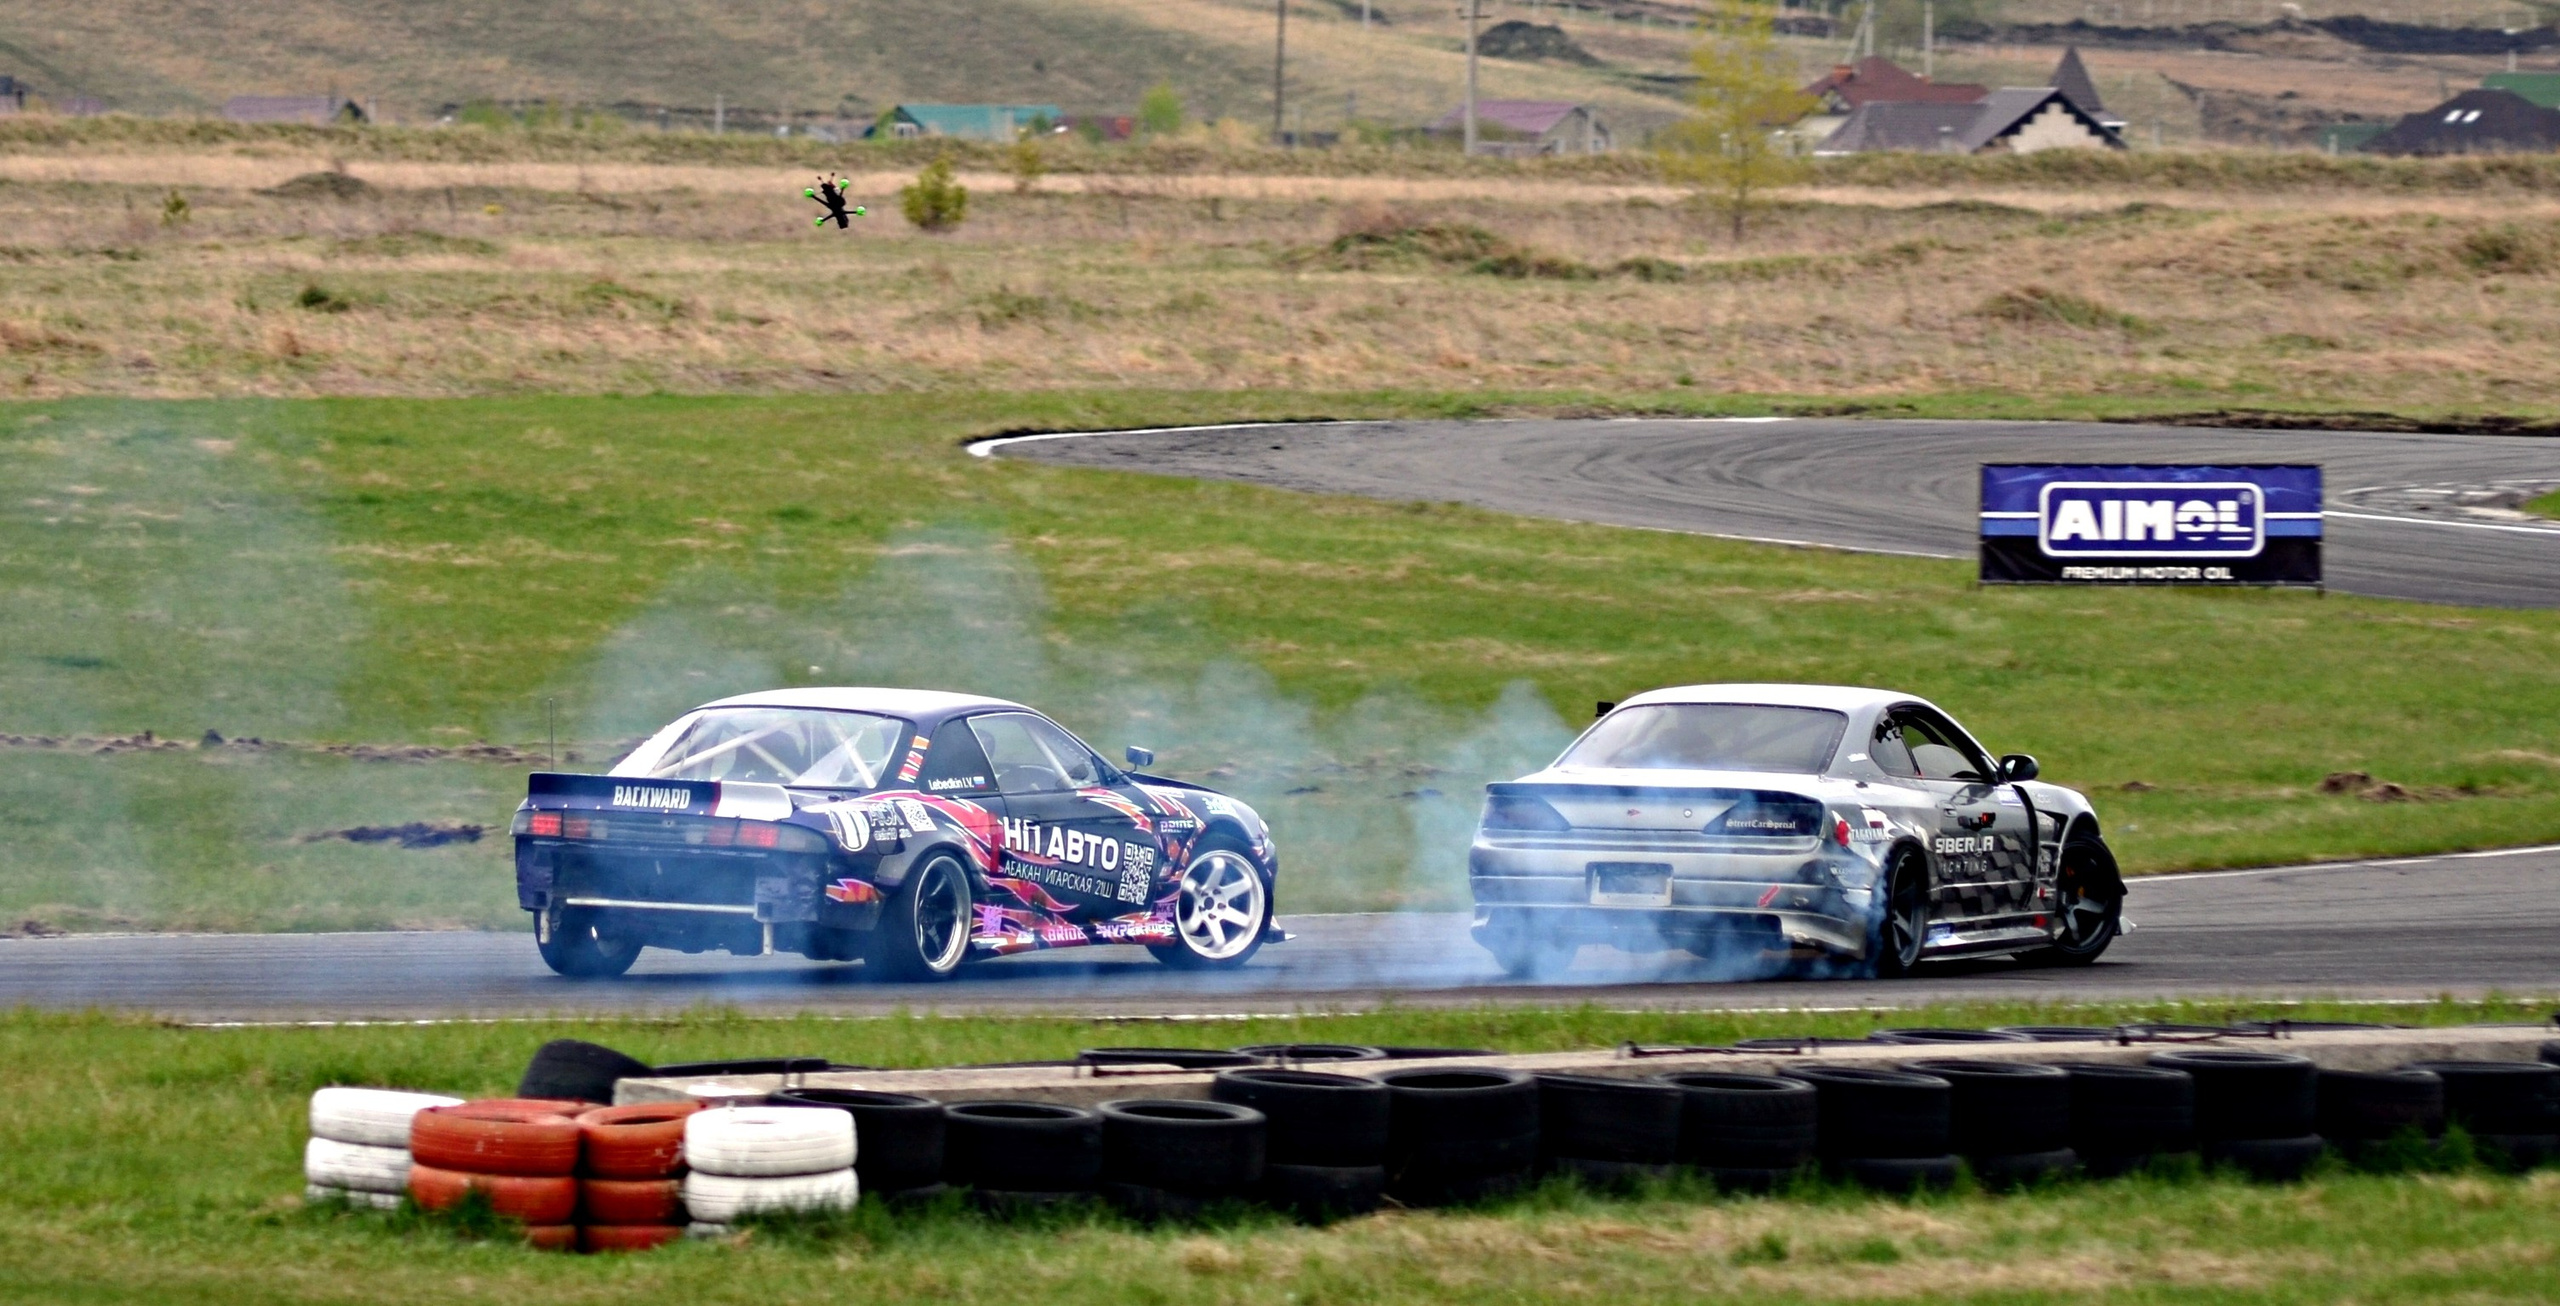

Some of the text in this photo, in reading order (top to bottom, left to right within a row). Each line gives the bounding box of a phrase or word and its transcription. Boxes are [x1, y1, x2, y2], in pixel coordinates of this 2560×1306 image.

[2050, 499, 2254, 542] AIMOL
[2061, 566, 2235, 580] PREMIUM MOTOR OIL
[612, 785, 691, 810] BACKWARD
[1046, 825, 1120, 871] АВТО
[1045, 867, 1093, 894] ИГАРСКАЯ
[1047, 925, 1085, 942] BRIDE
